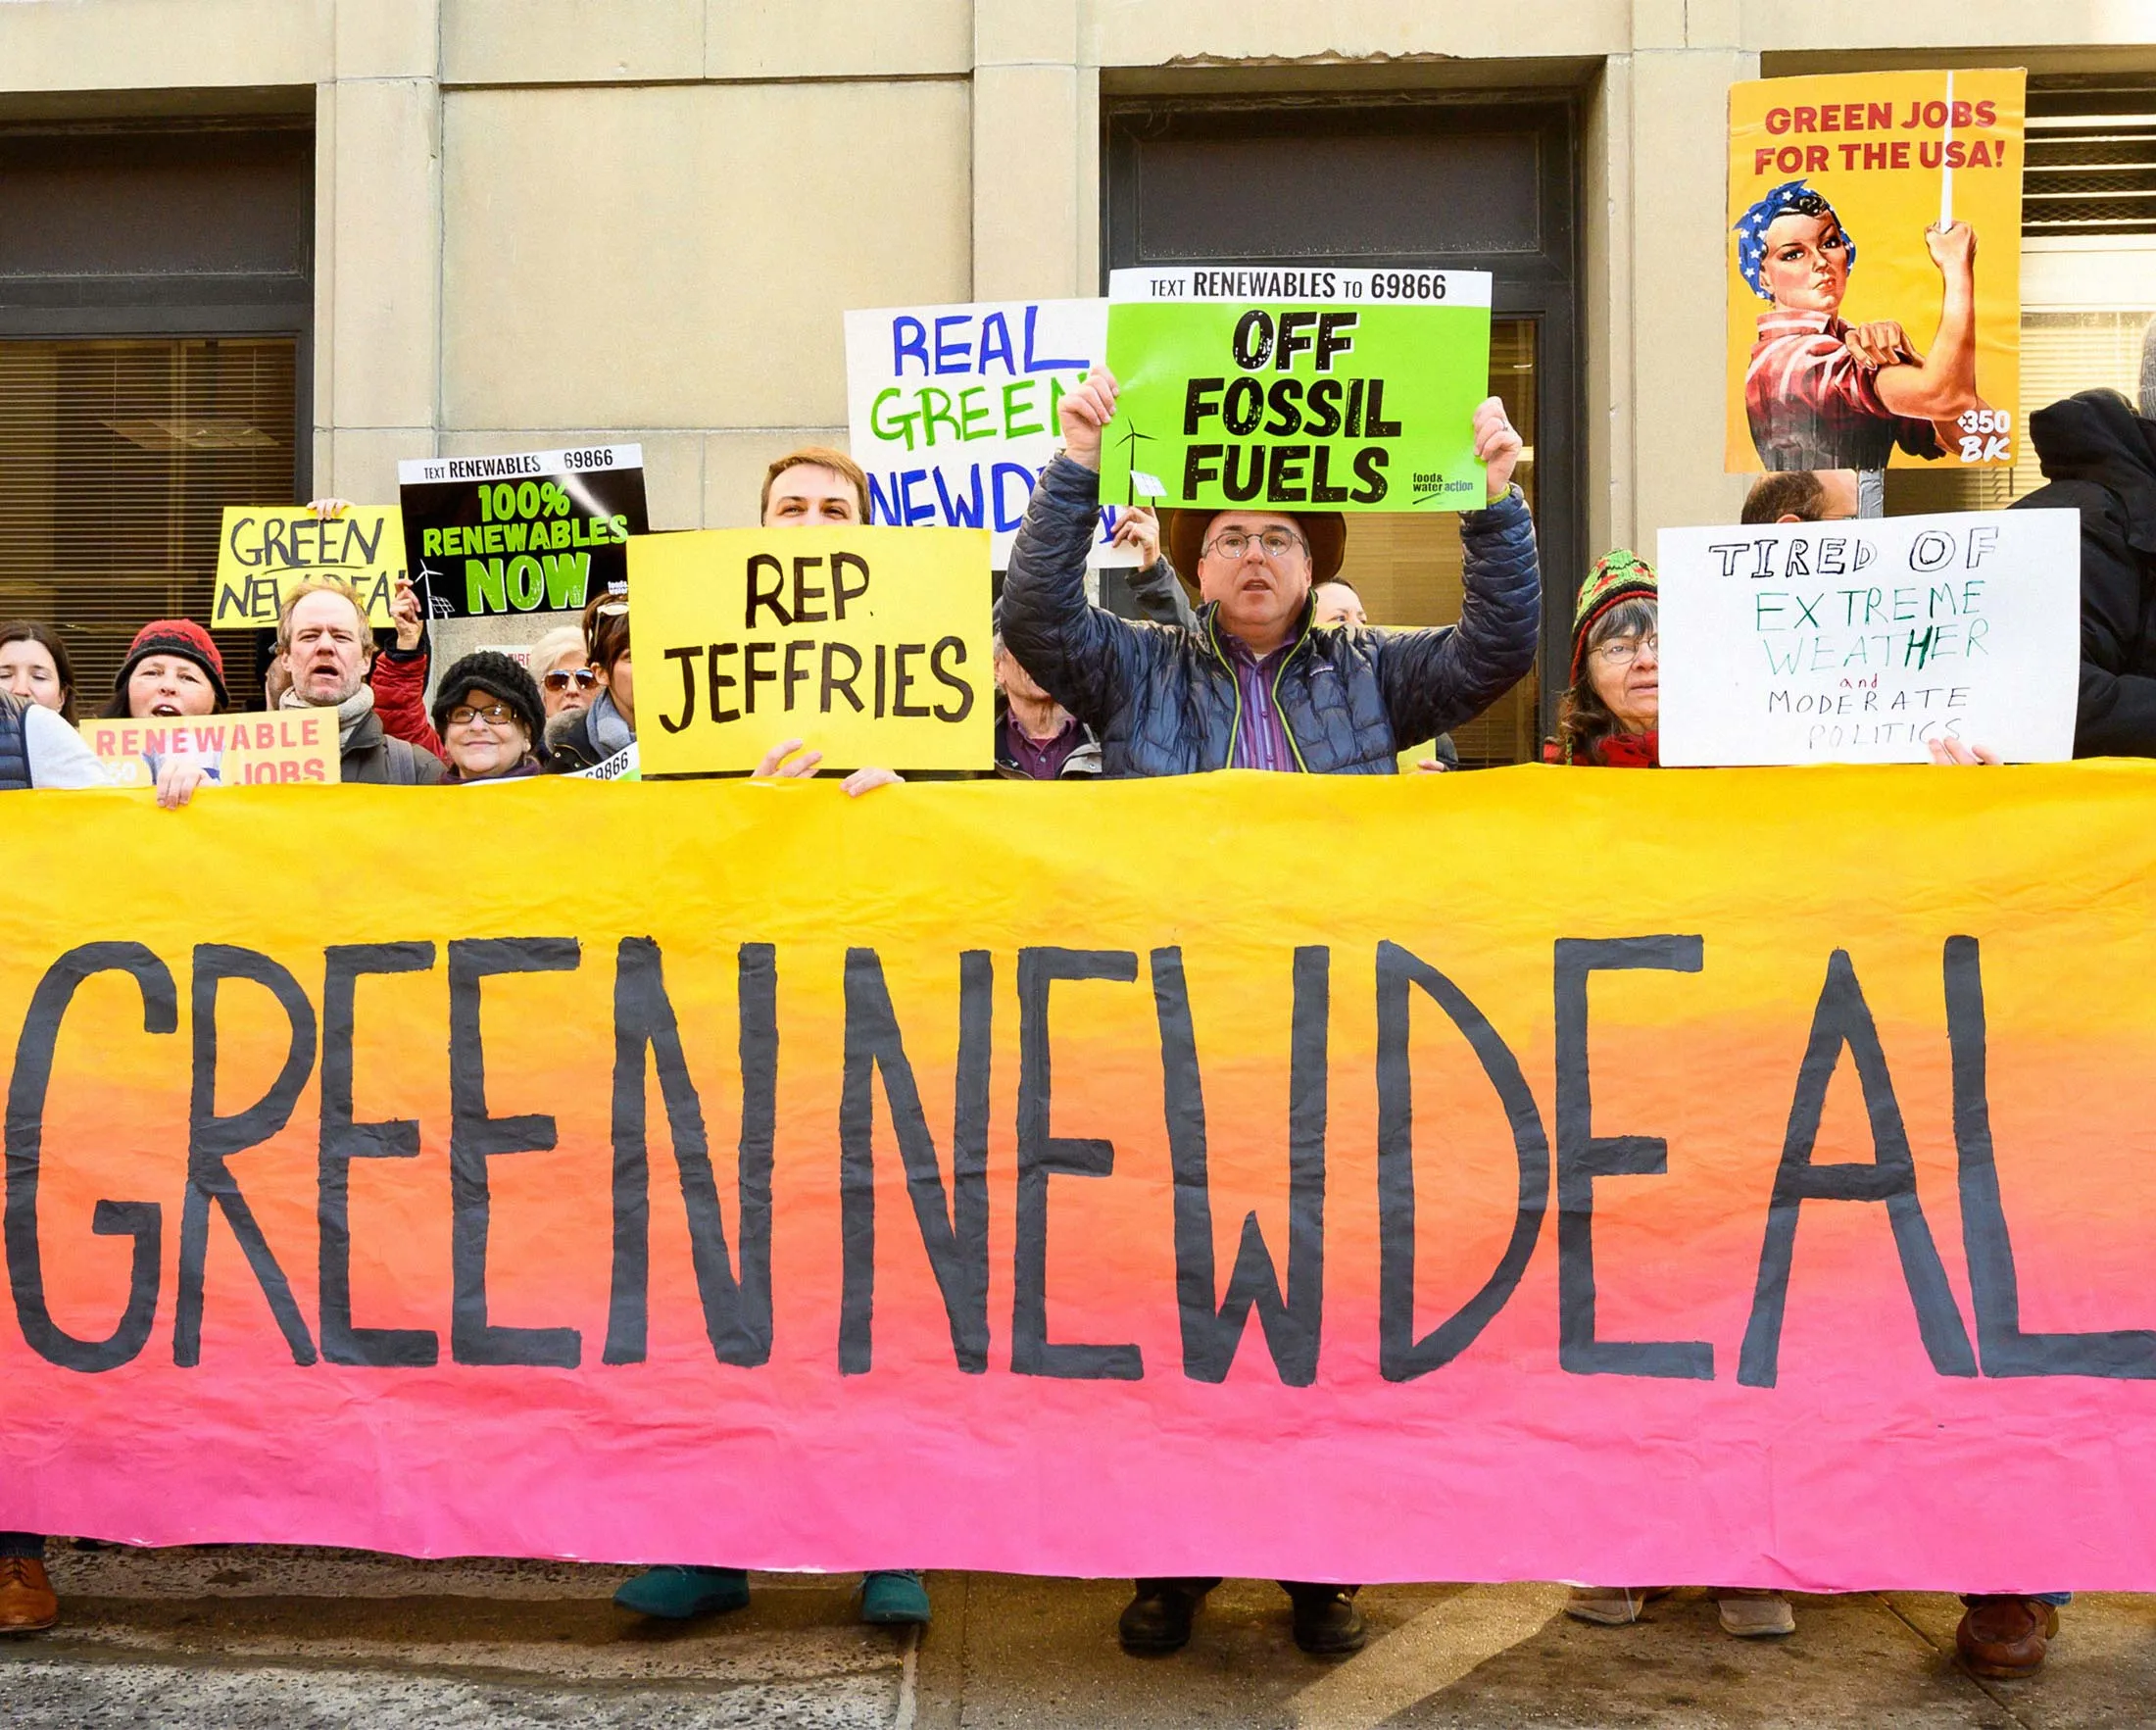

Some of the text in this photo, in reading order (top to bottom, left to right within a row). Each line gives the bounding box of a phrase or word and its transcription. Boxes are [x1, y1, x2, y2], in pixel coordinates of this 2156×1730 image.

[1765, 100, 1997, 135] GREEN JOBS
[1754, 139, 2006, 175] FOR THE USA!
[1151, 272, 1447, 300] TEXT RENEWABLES TO 69866
[893, 305, 1091, 376] REAL
[1232, 309, 1358, 371] OFF
[1183, 376, 1403, 438] FOSSIL
[1957, 409, 2011, 434] 350
[423, 448, 613, 480] TEXT RENEWABLES 69866
[1958, 434, 2011, 463] BK
[1182, 444, 1390, 504] FUELS
[1413, 472, 1444, 482] food&
[1413, 479, 1474, 492] water action
[478, 481, 570, 522] 100%
[230, 518, 384, 568] GREEN
[423, 515, 628, 557] RENEWABLES
[1709, 526, 2000, 579] TIRED OF
[466, 552, 591, 615] NOW
[745, 552, 874, 629] REP.
[1755, 580, 1986, 632] EXTREME
[1763, 618, 1989, 675] WEATHER
[659, 635, 975, 733] JEFFRIES
[1769, 687, 1971, 715] MODERATE
[1839, 673, 1878, 689] and
[96, 719, 319, 757] RENEWABLE
[1808, 717, 1962, 750] POLITICS
[3, 934, 2156, 1387] GREEN NEW DEAL
